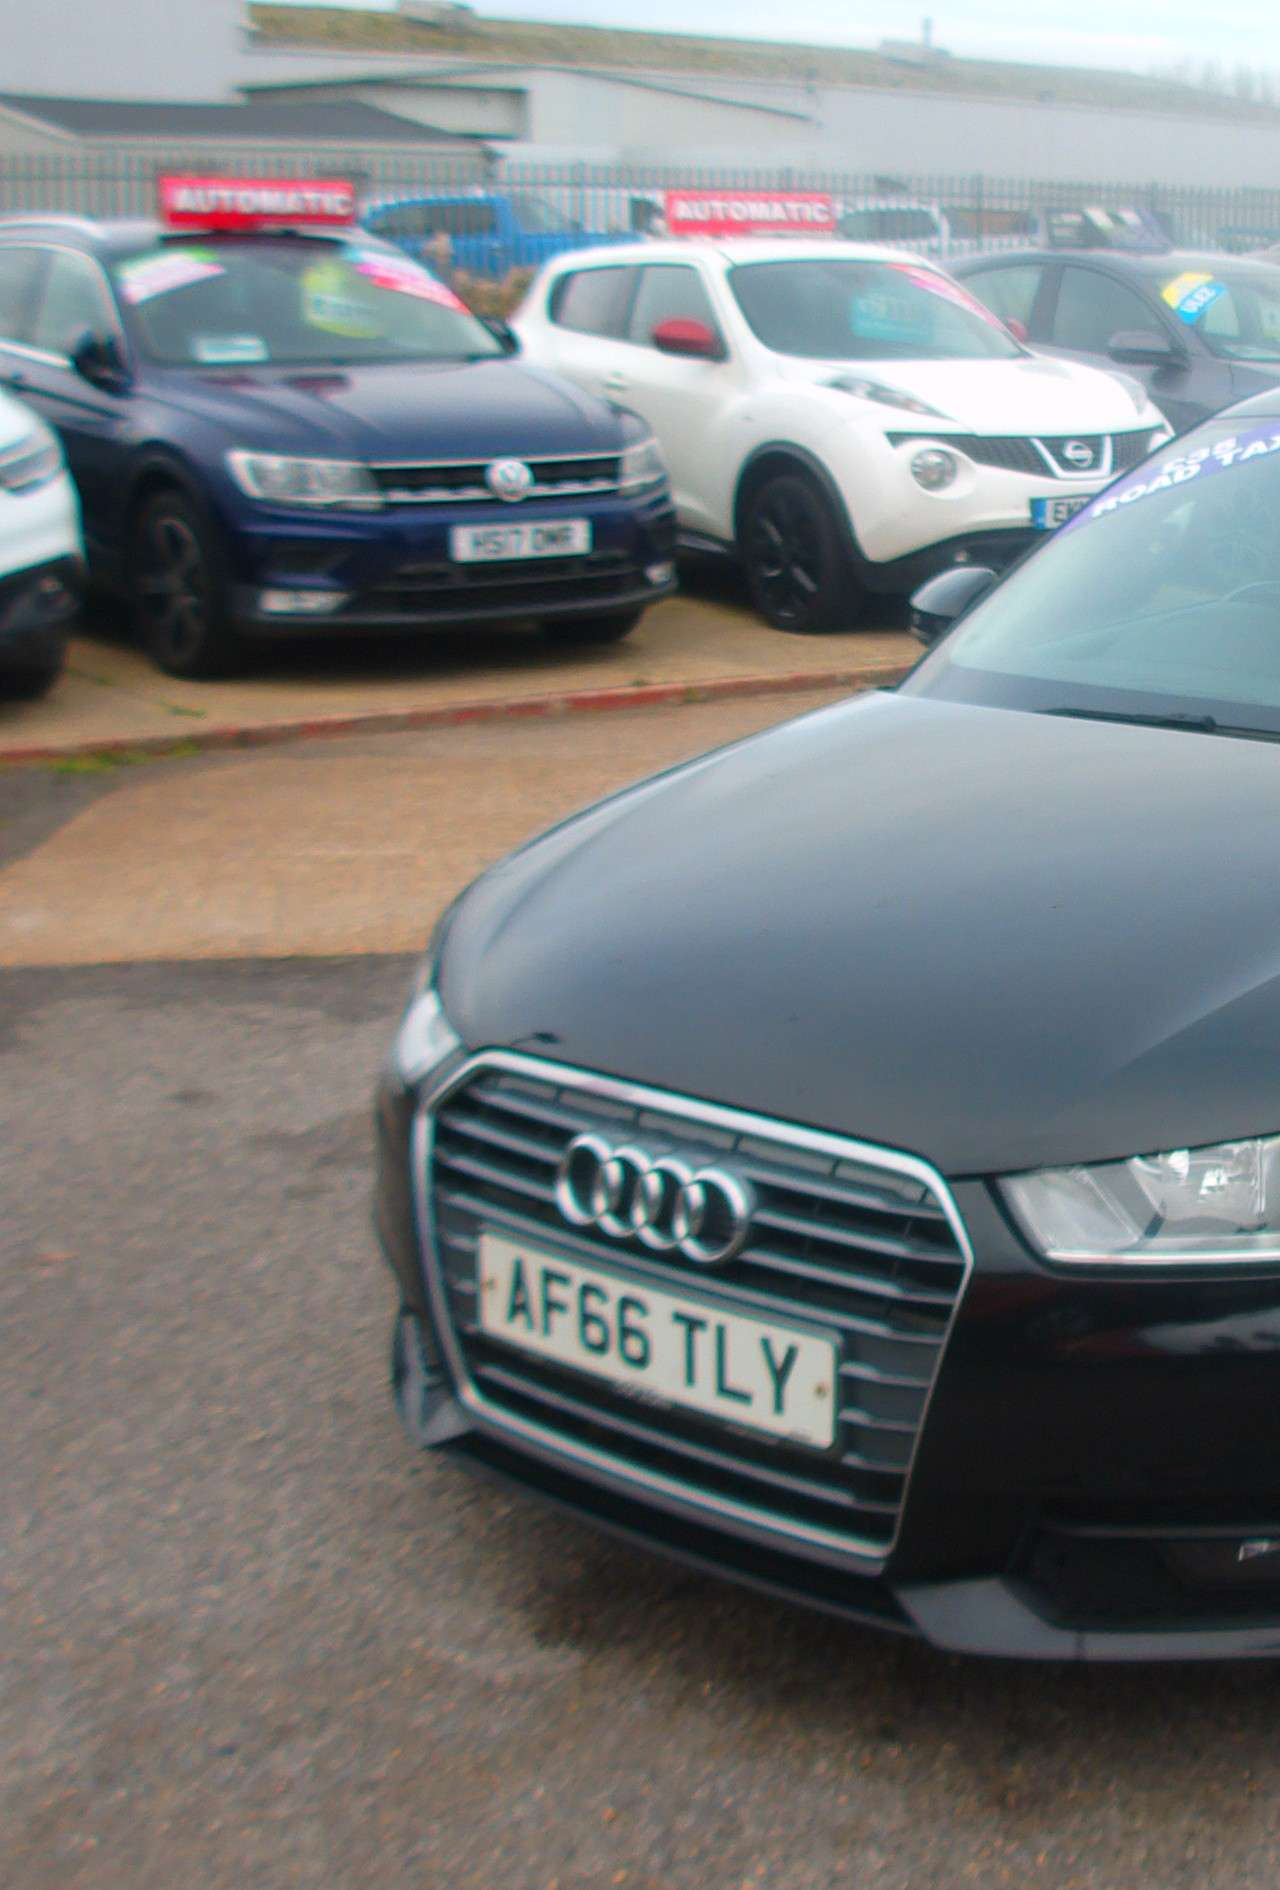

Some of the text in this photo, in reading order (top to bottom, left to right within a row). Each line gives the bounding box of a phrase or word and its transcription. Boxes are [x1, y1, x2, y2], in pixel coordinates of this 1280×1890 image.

[172, 186, 352, 215] AUTOMATIC
[675, 200, 831, 225] AUTOMATIC
[1091, 463, 1201, 518] ROAD
[507, 1257, 799, 1415] AF66 TLY
